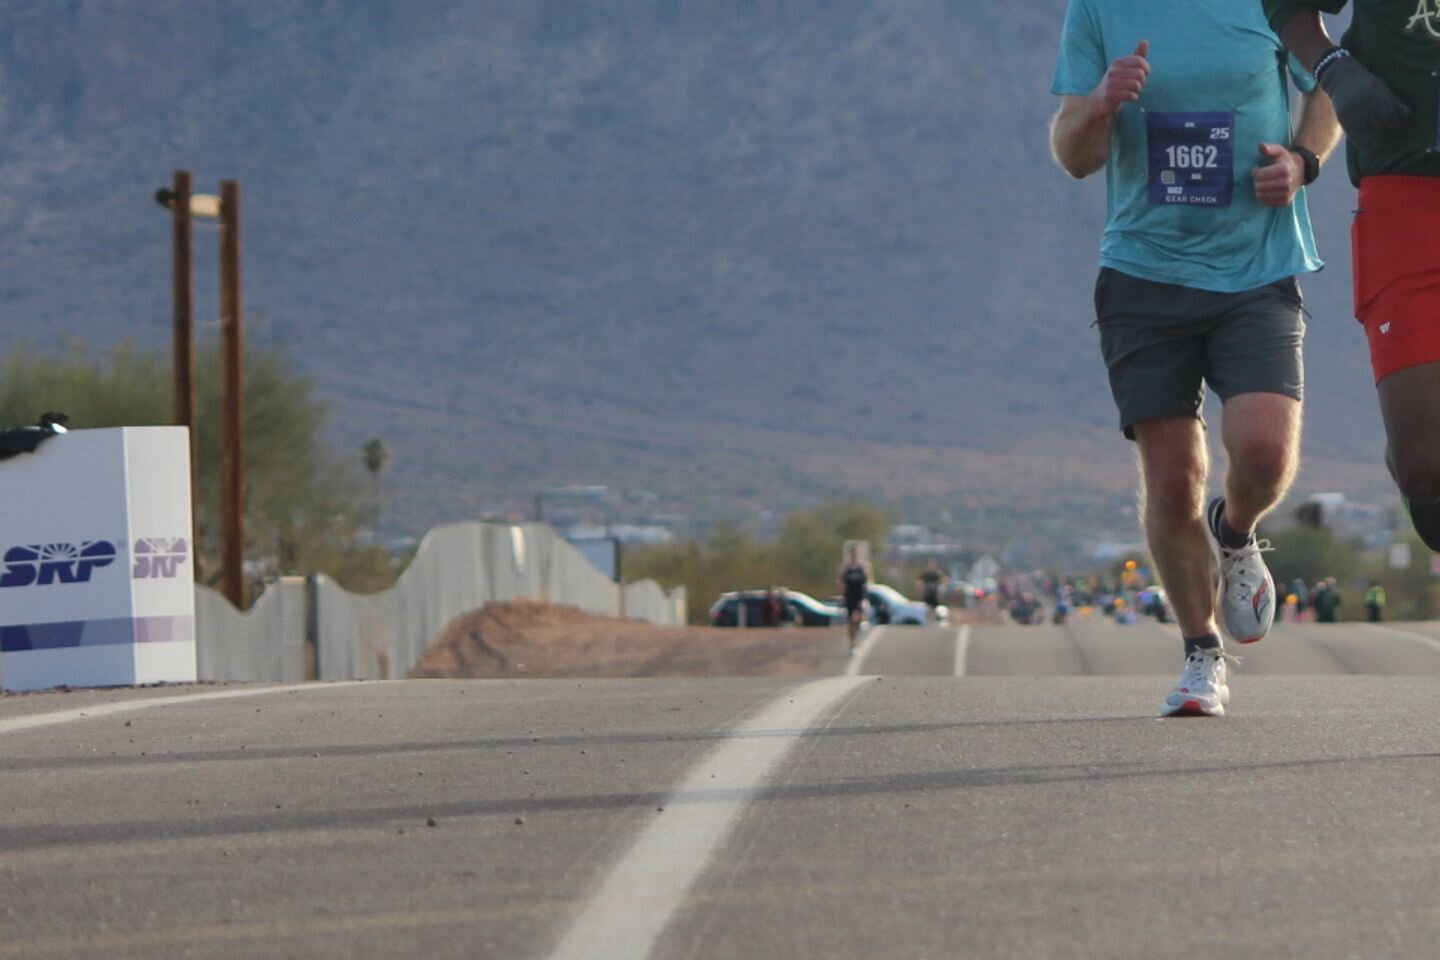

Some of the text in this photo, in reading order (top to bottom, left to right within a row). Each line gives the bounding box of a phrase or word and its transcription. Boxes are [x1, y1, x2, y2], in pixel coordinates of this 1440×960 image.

[1209, 127, 1230, 139] 25
[1165, 145, 1218, 168] 1662
[0, 540, 116, 588] SRP
[133, 538, 188, 578] SRP
